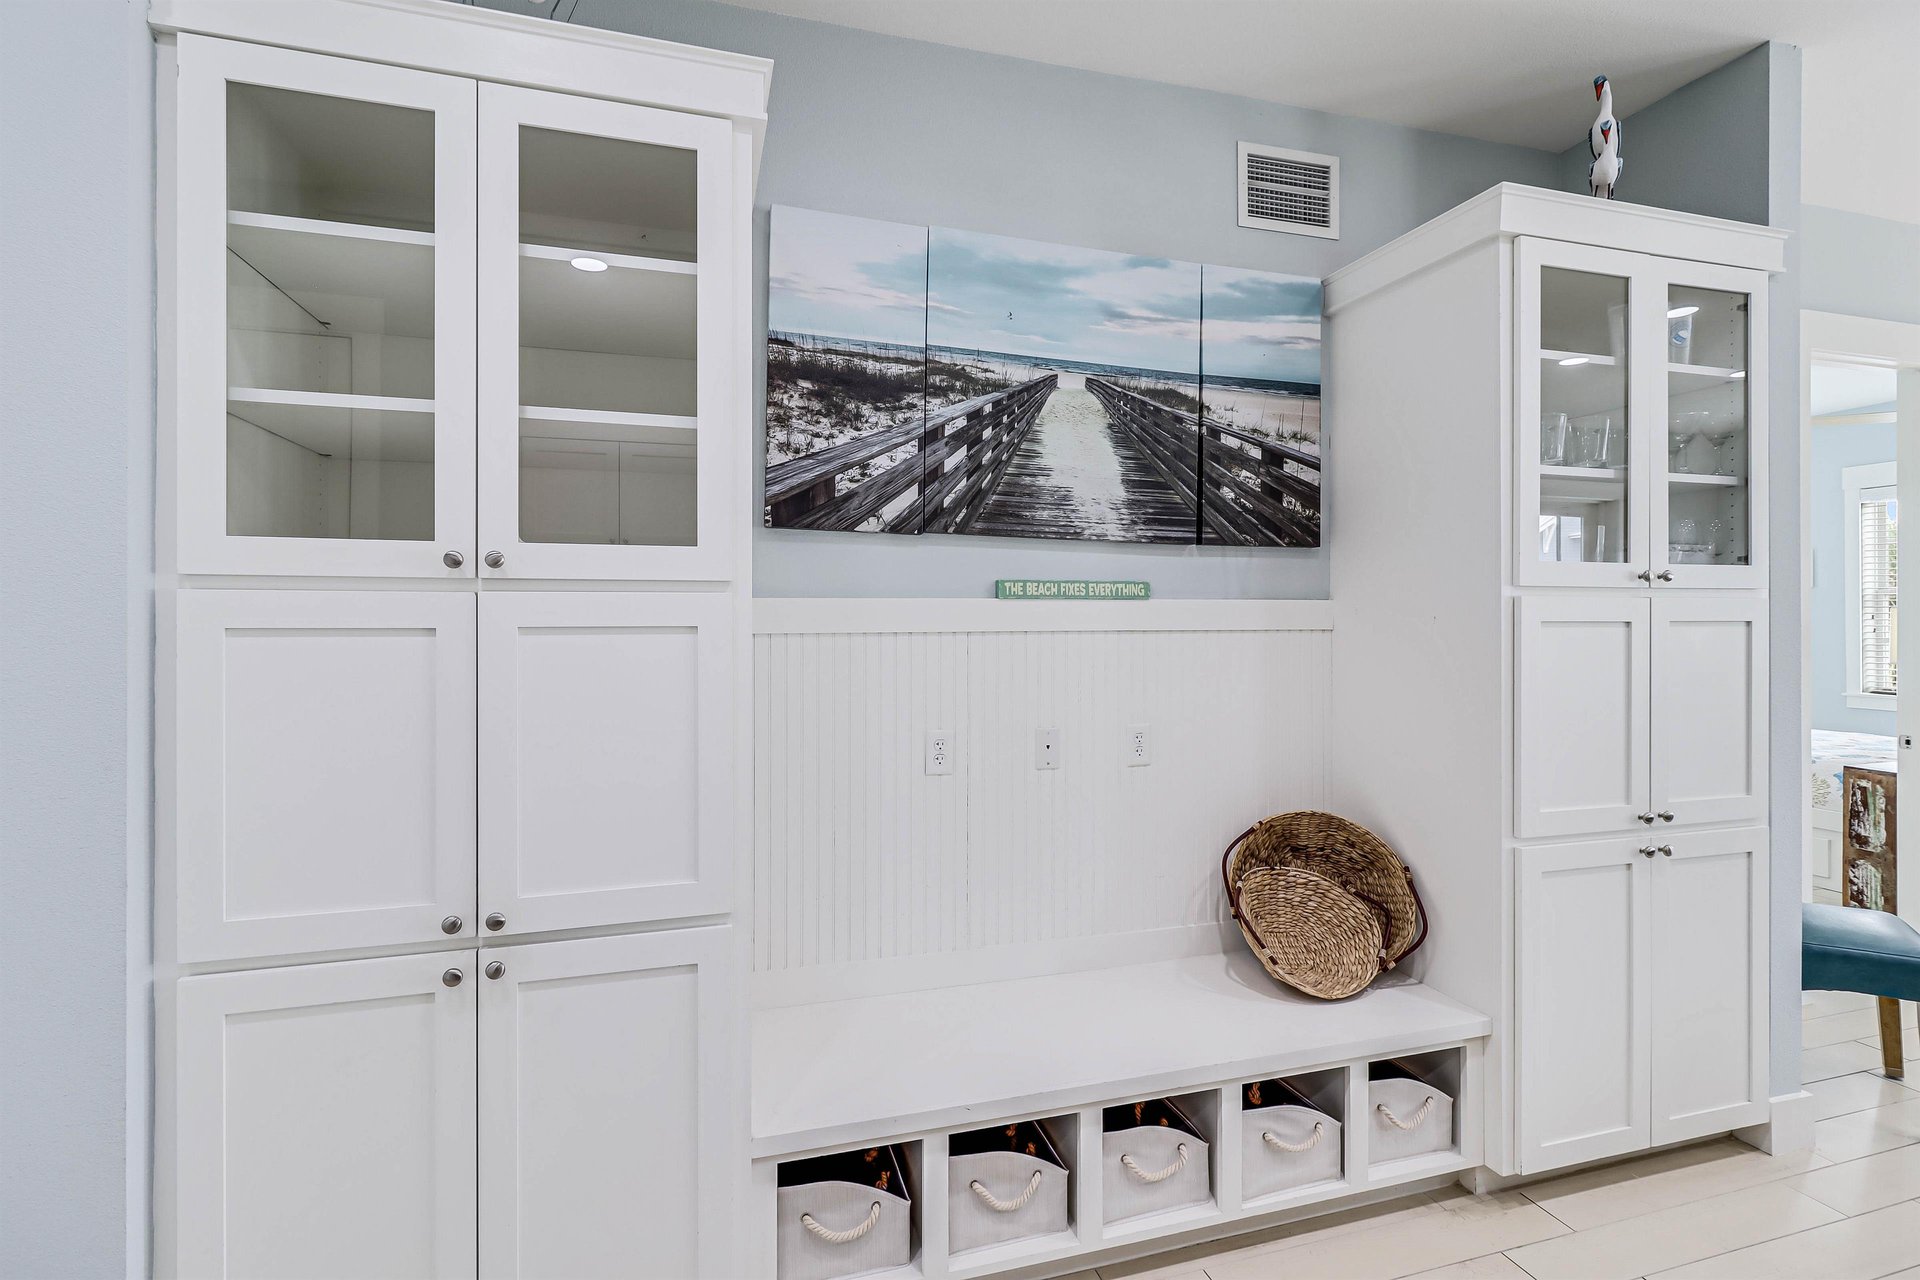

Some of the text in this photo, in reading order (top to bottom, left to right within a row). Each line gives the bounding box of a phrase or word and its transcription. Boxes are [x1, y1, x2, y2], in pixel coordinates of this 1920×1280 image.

[1004, 582, 1145, 596] THE BEACH FIXES EVERYTHING
